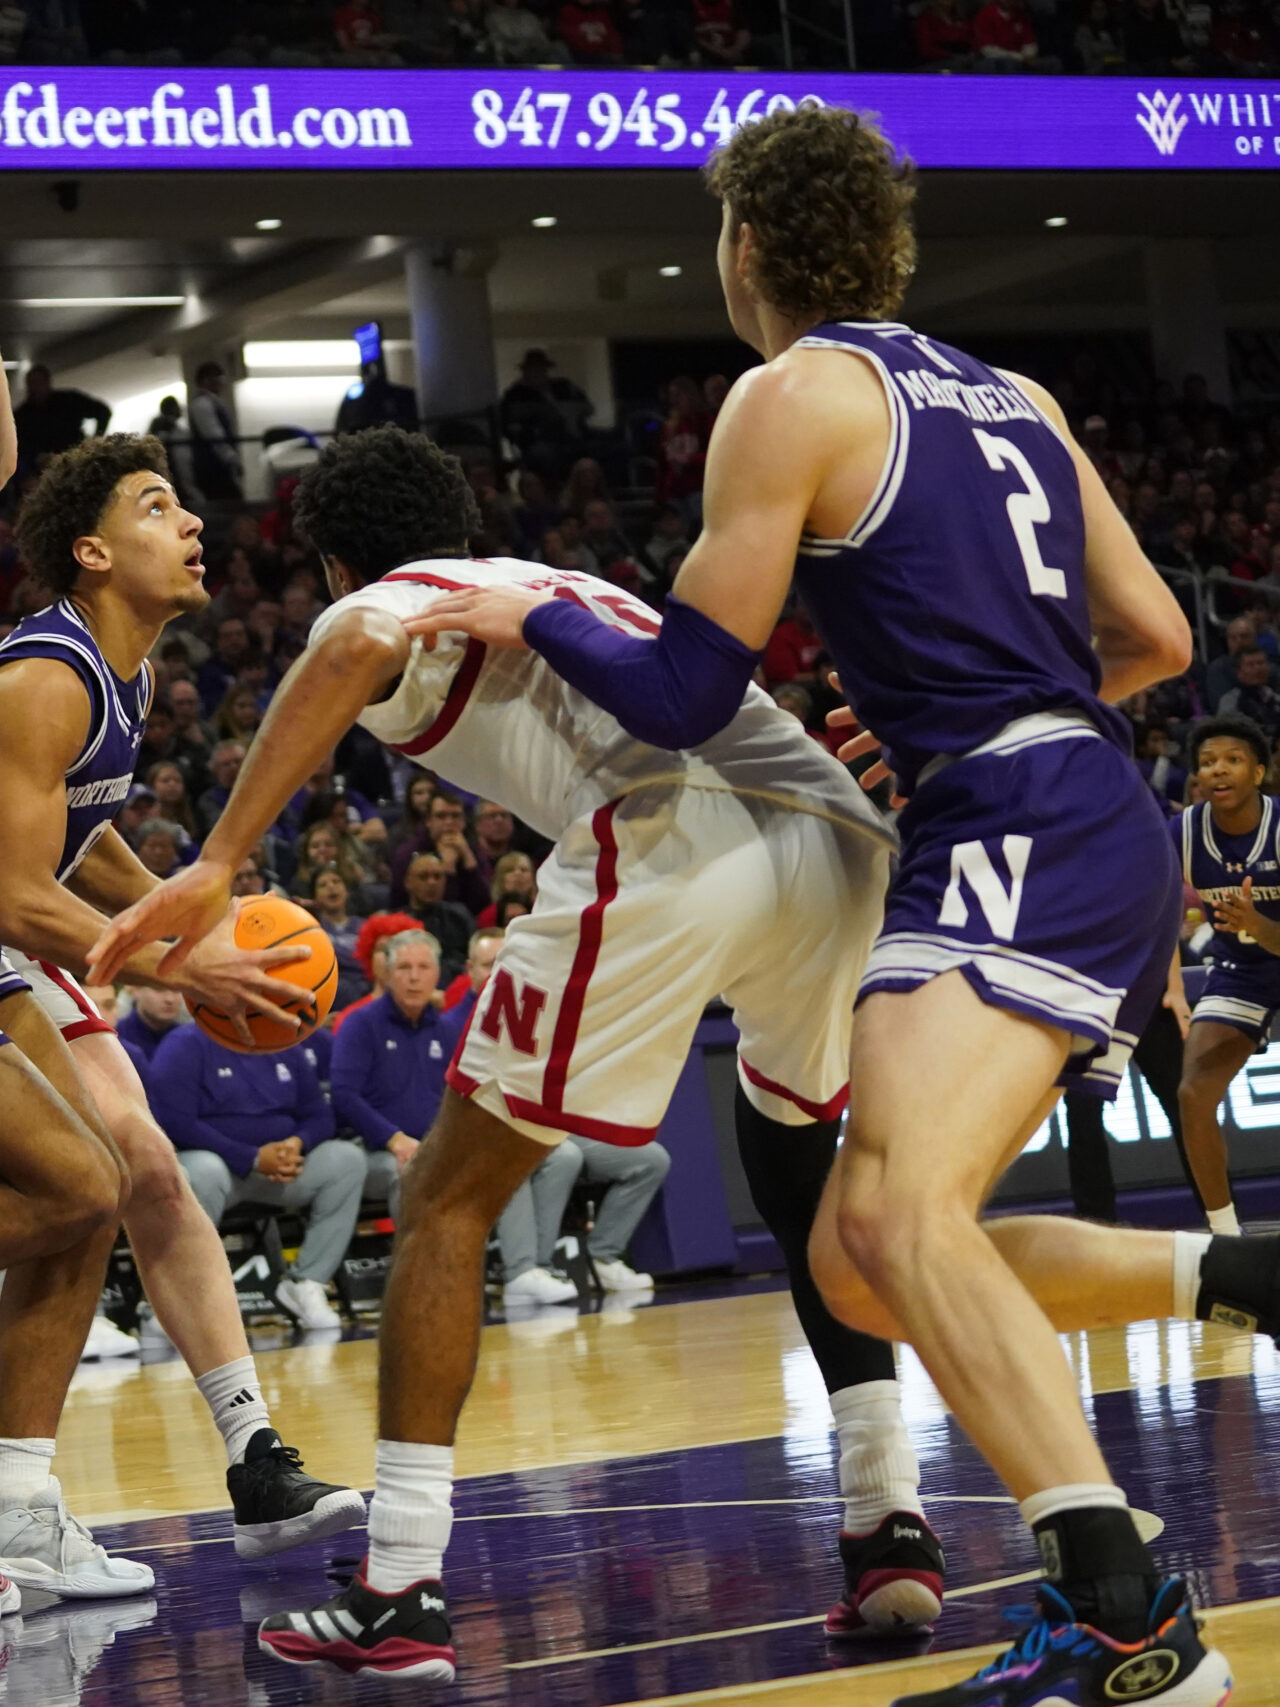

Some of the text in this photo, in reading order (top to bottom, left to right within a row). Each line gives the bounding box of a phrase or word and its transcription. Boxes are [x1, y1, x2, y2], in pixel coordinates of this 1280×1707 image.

[1235, 136, 1263, 155] OF
[972, 428, 1068, 599] 2
[937, 834, 1034, 942] N
[478, 964, 550, 1058] N
